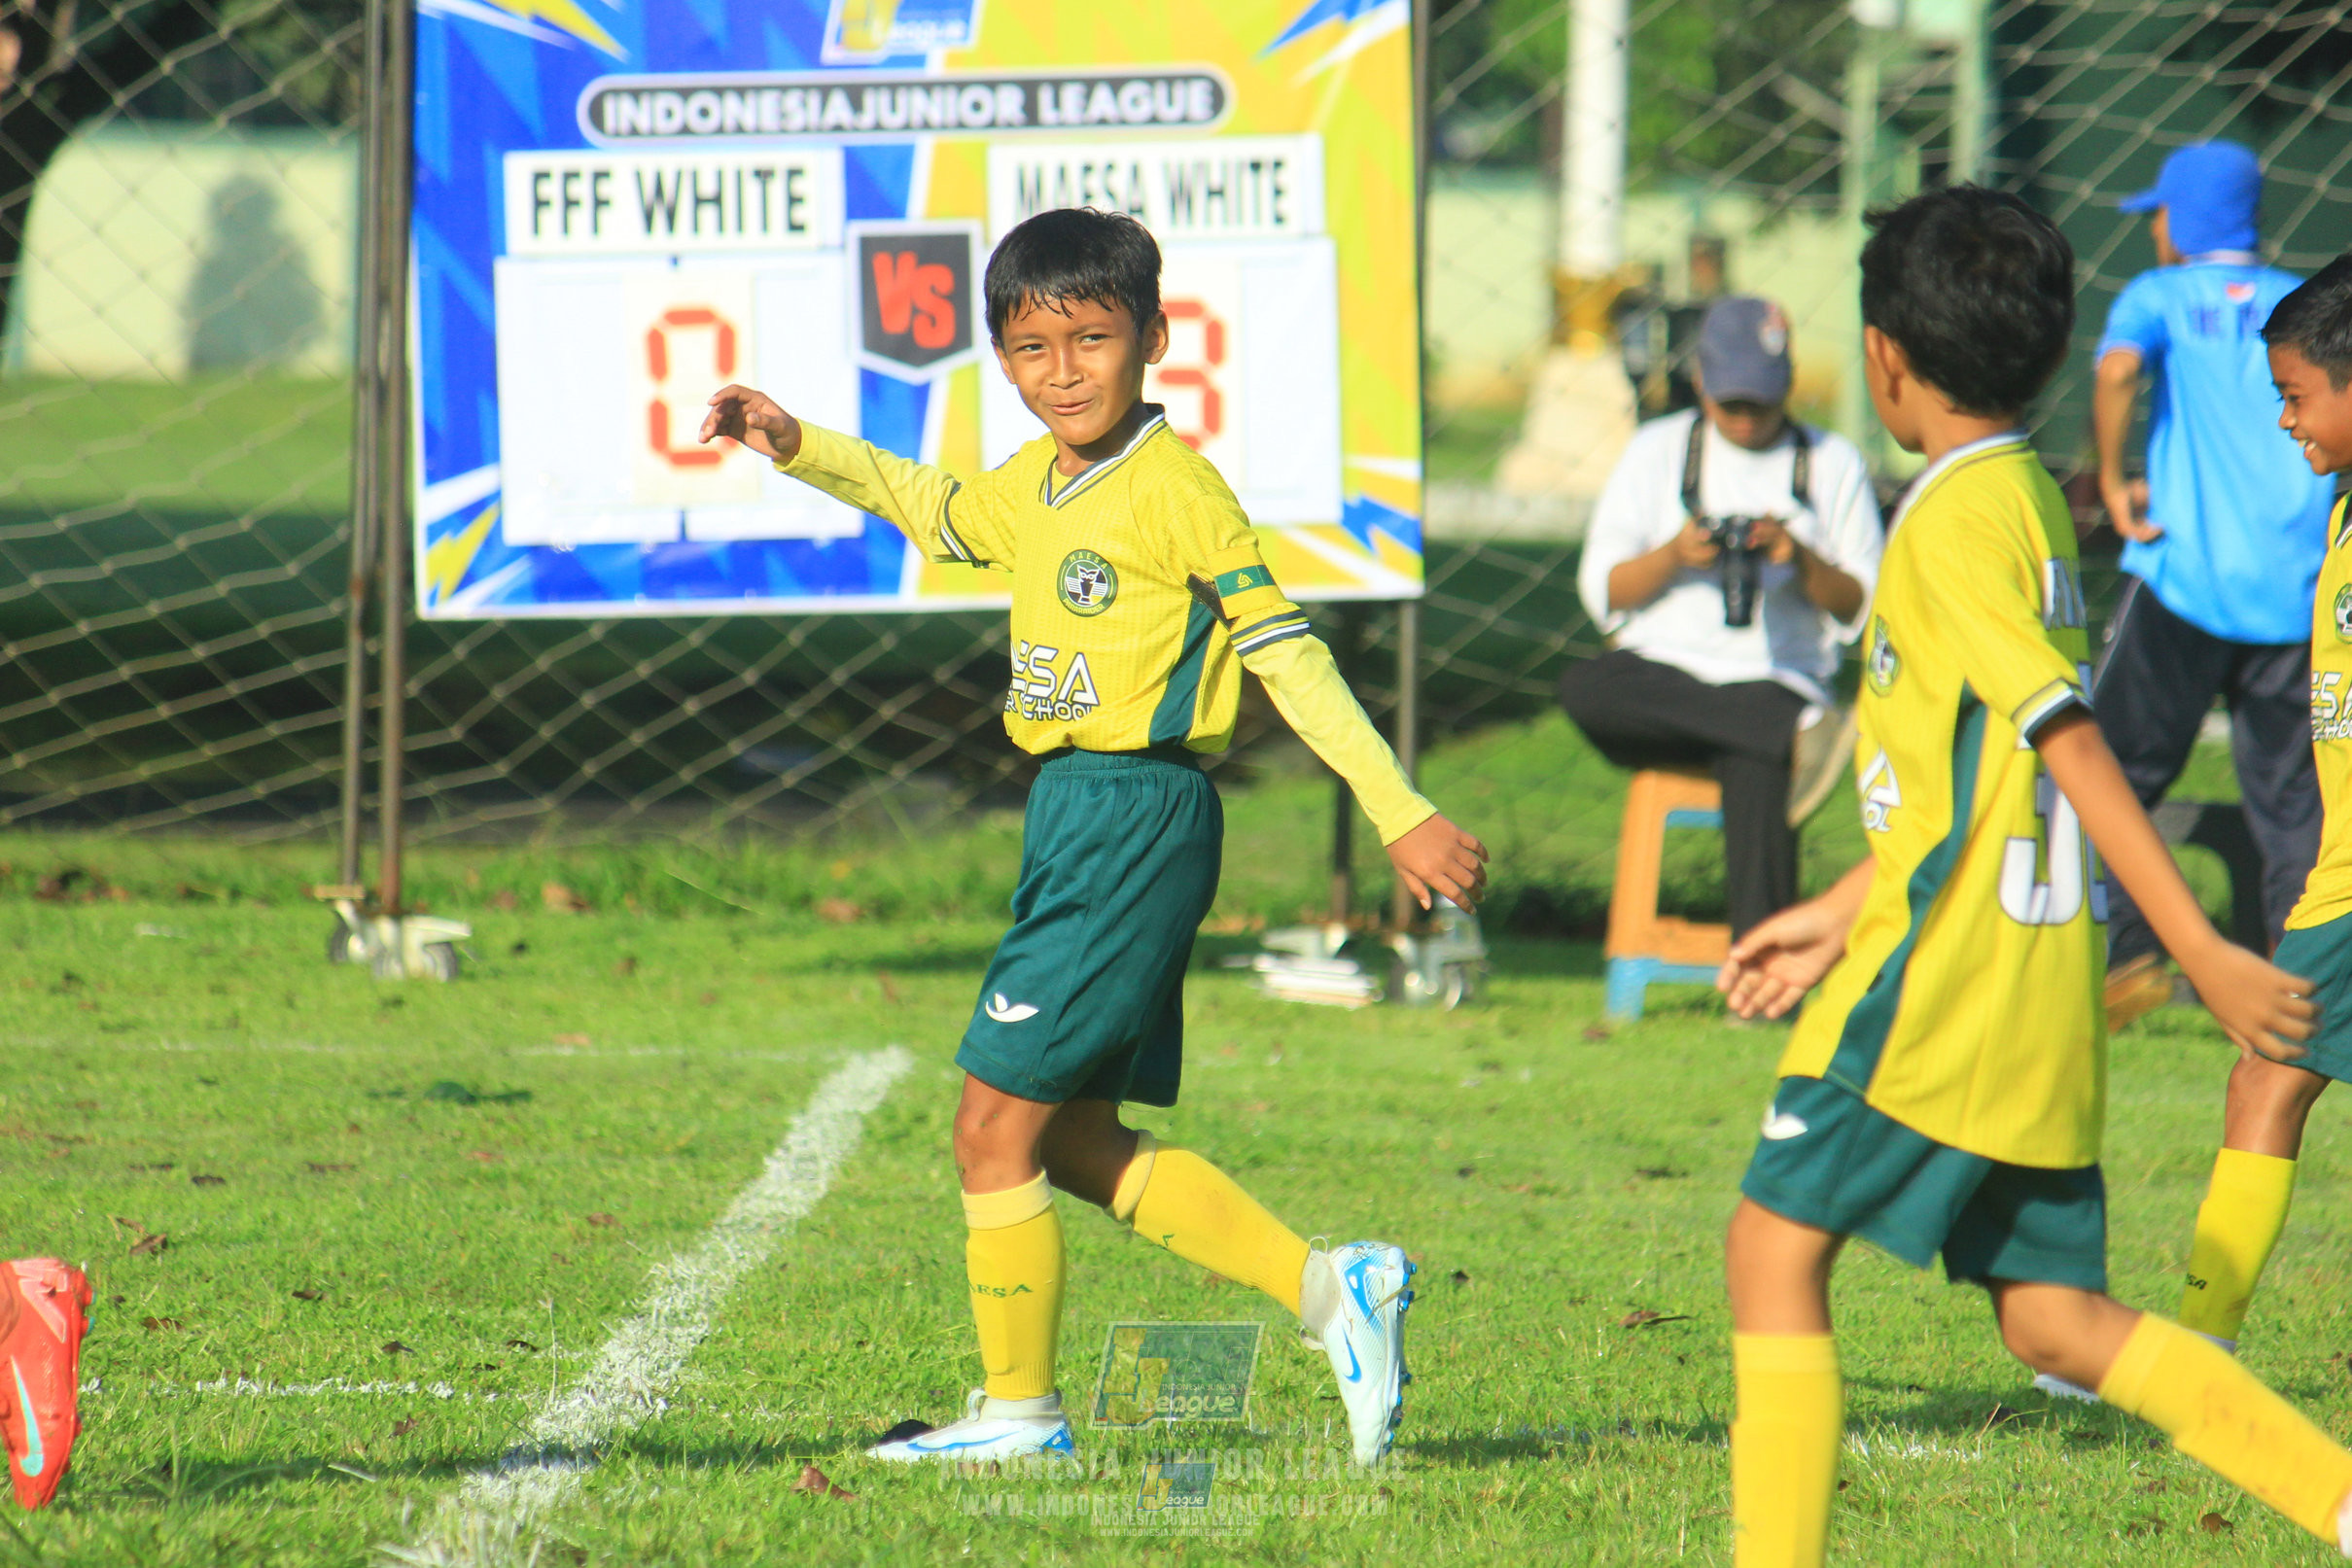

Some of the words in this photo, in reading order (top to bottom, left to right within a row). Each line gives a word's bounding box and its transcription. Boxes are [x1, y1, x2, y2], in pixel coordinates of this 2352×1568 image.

[1036, 77, 1214, 125] LEAGUE
[531, 169, 614, 237] FFF
[635, 166, 808, 235] WHITE
[1163, 157, 1290, 226] WHITE
[871, 251, 956, 350] VS
[646, 308, 739, 467] 0
[1157, 299, 1225, 451] 3
[1069, 551, 1109, 570] MAESA
[1020, 690, 1092, 722] CHOO
